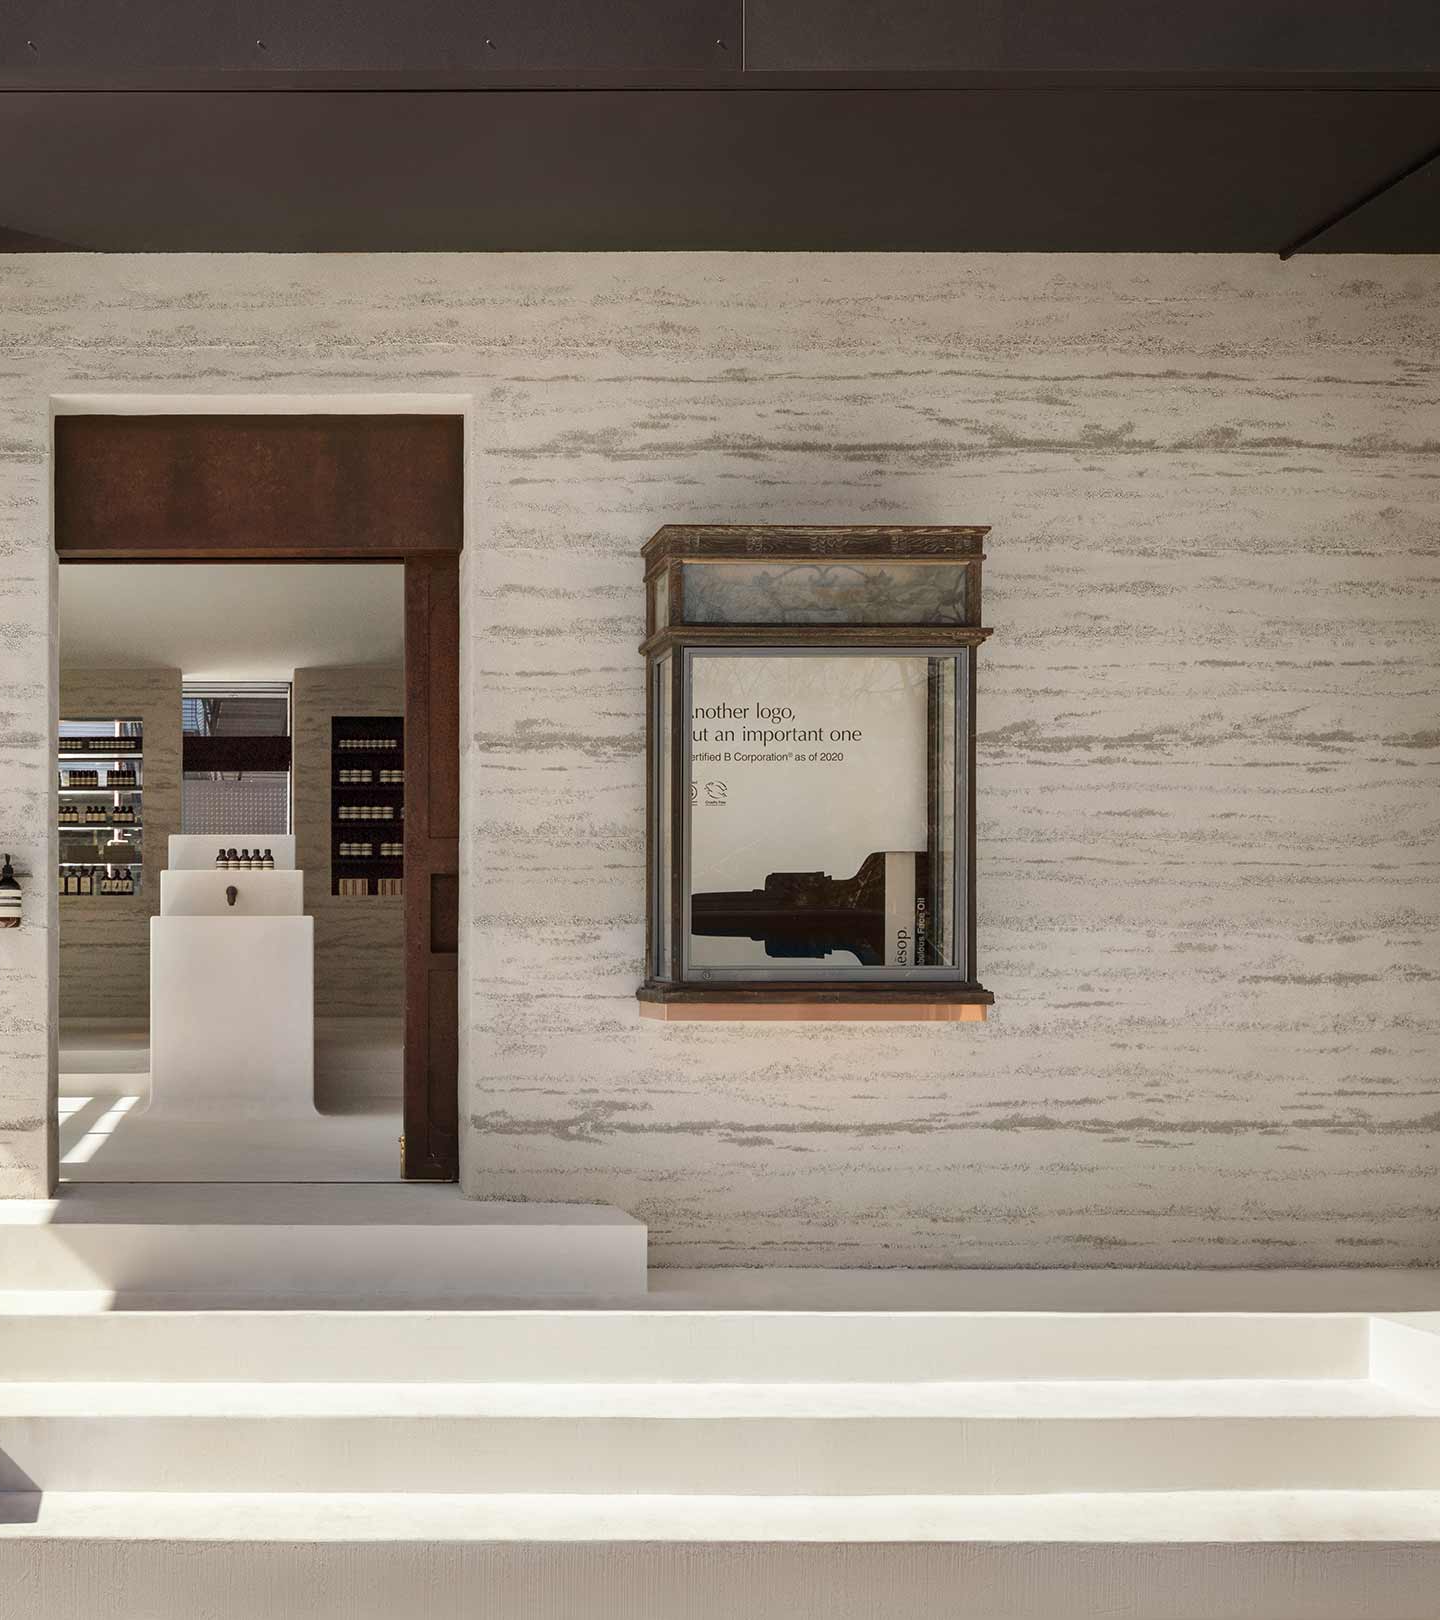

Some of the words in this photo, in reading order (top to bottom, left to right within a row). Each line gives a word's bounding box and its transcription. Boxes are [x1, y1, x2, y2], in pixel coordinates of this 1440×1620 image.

[692, 702, 750, 719] nother
[756, 702, 796, 724] logo,
[692, 728, 709, 742] ut
[715, 729, 735, 742] an
[742, 726, 824, 747] important
[829, 729, 862, 742] one
[691, 752, 721, 762] ertified
[724, 752, 731, 761] B
[795, 754, 806, 762] as
[809, 752, 818, 762] of
[820, 752, 844, 762] 2020
[917, 897, 926, 911] Oil
